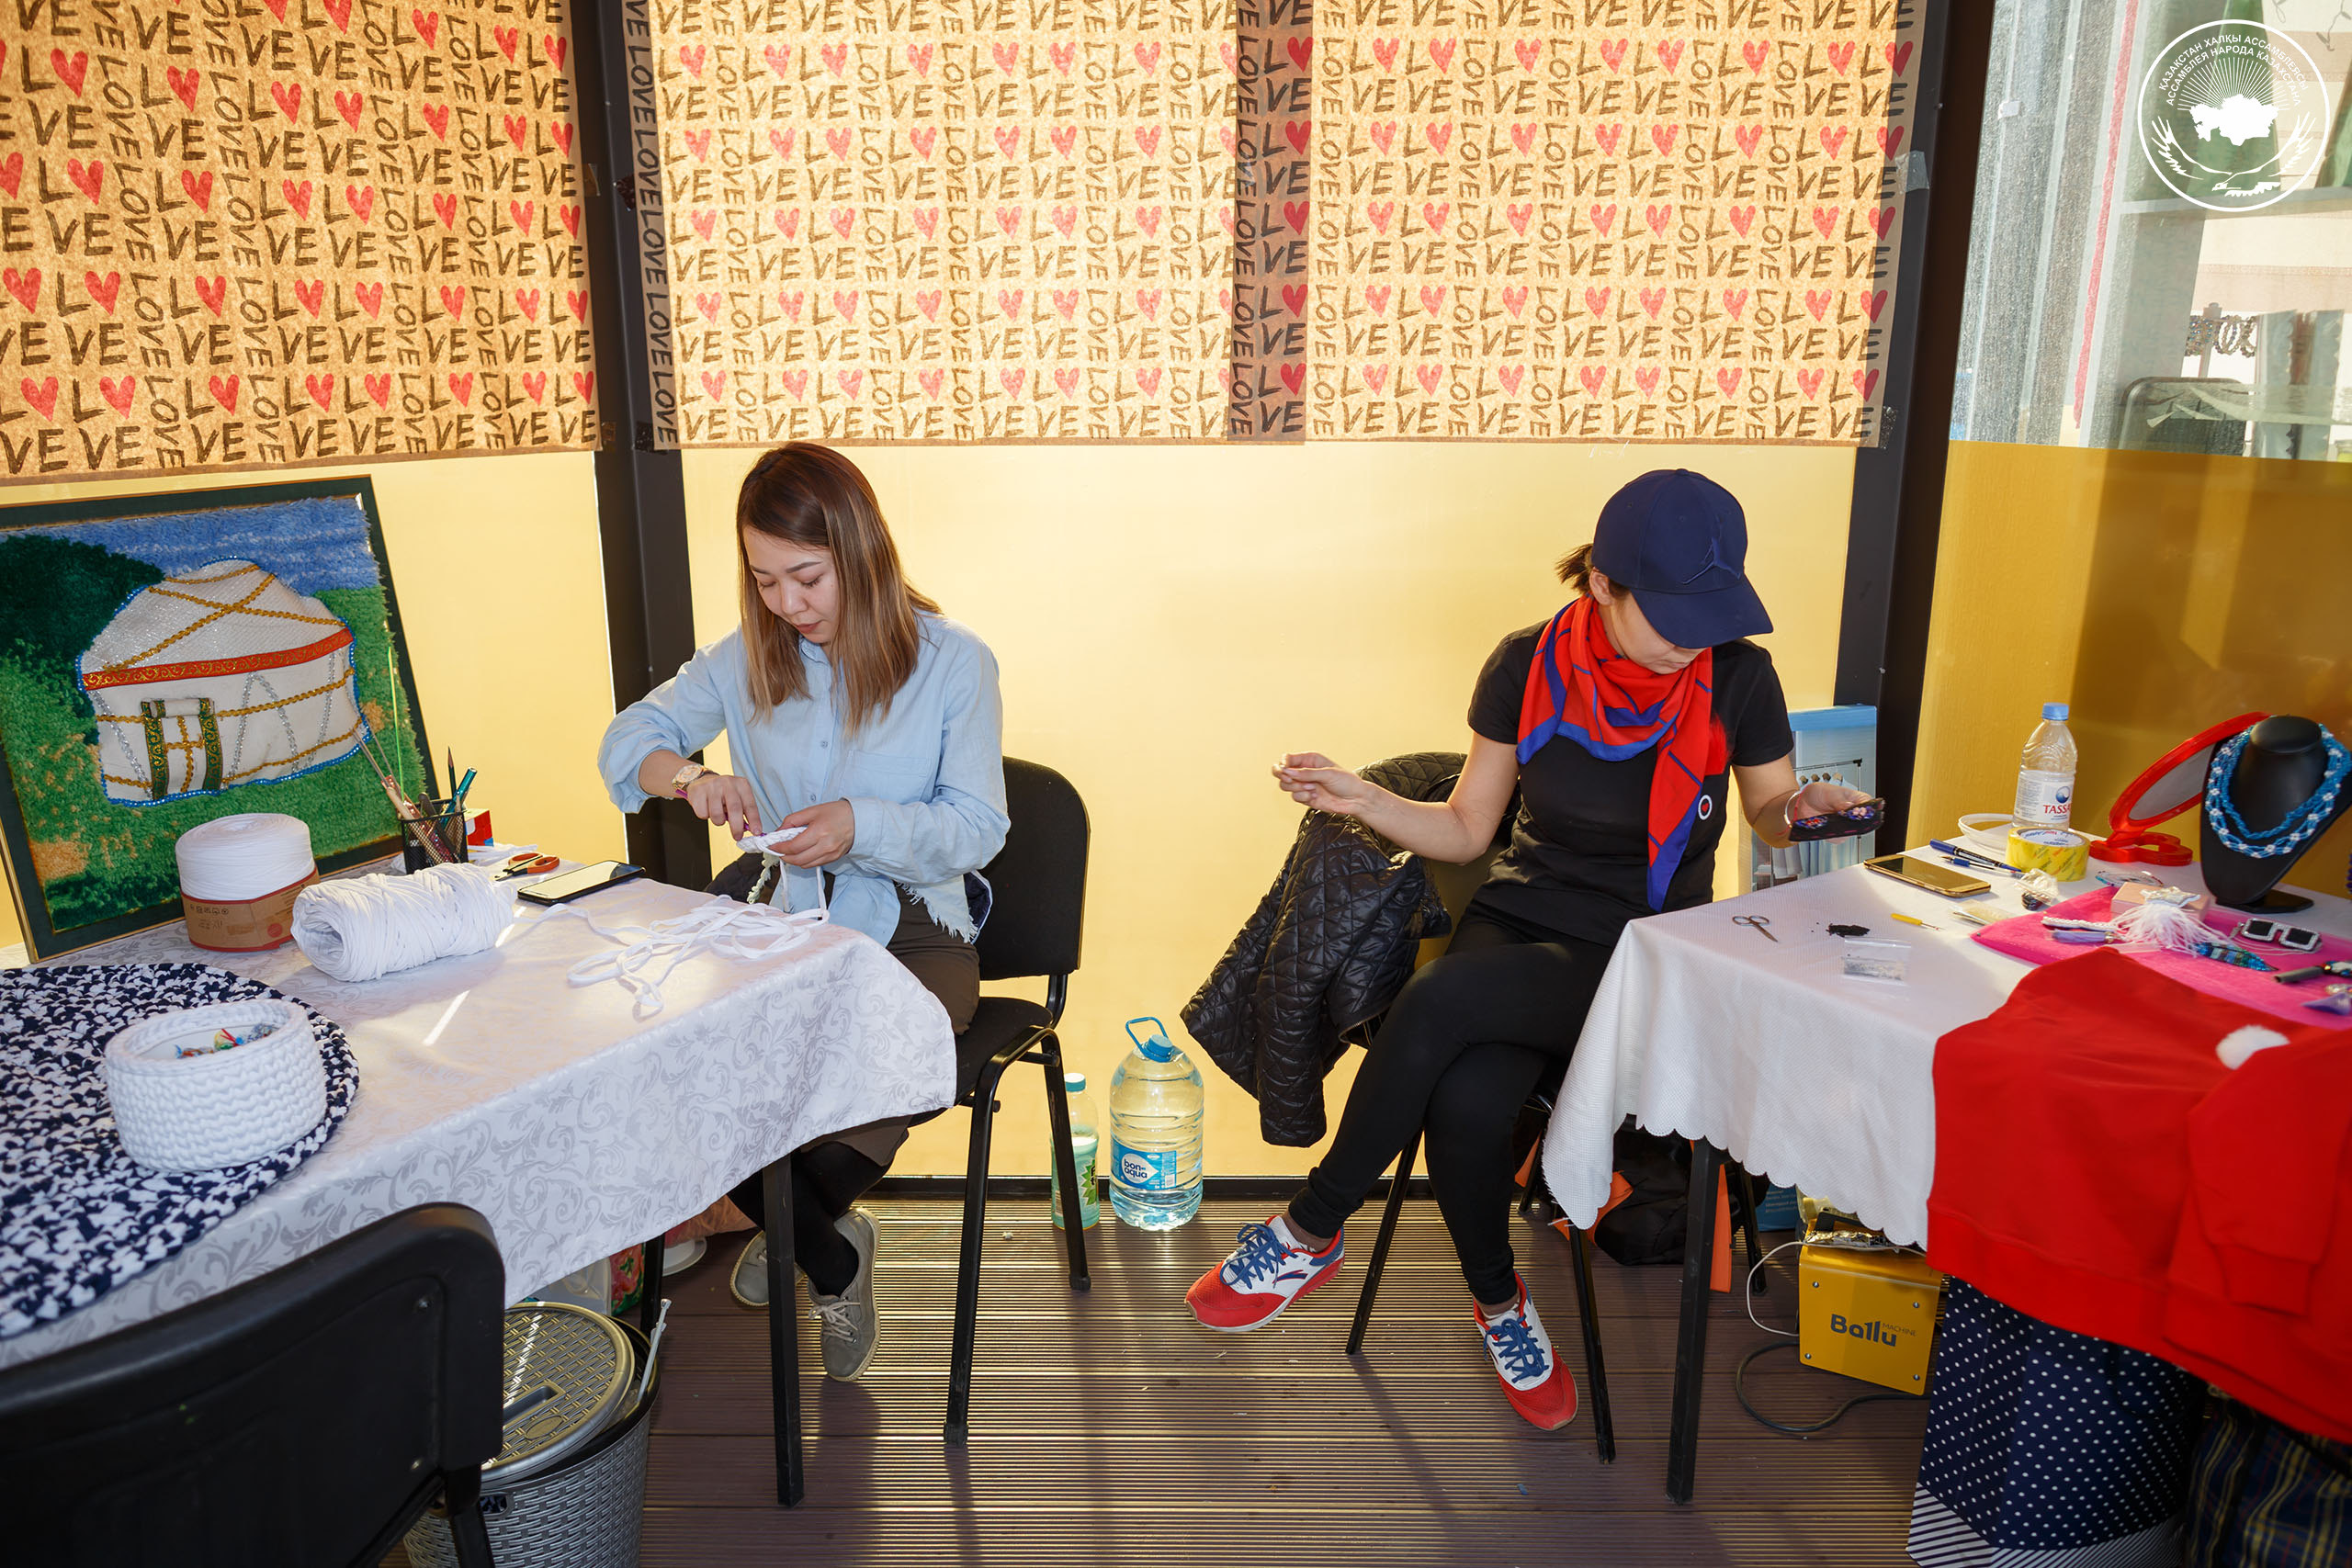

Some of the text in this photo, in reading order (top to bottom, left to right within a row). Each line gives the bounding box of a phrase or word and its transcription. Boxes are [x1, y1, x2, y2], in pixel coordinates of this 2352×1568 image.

[98, 56, 185, 467] LOVE LOVE LOVE LOVE
[210, 73, 286, 462] LOVE LOVE LOVE LOVE
[360, 0, 427, 454] LOVE LOVE LOVE LOVE LOVE
[447, 16, 504, 447] LOVE LOVE LOVE LOVE LOVE
[630, 46, 679, 444] LOVE LOVE LOVE LOVE LOVE
[716, 47, 759, 442] LOVE LOVE LOVE LOVE LOVE
[856, 45, 895, 440] LOVE LOVE LOVE LOVE LOVE
[943, 43, 974, 438] LOVE LOVE LOVE LOVE LOVE
[1085, 42, 1110, 438] LOVE LOVE LOVE LOVE LOVE
[1170, 43, 1193, 438] LOVE LOVE LOVE LOVE LOVE
[1231, 34, 1259, 435] LOVE LOVE LOVE LOVE LOVE
[1316, 39, 1345, 434] LOVE LOVE LOVE LOVE LOVE
[1450, 40, 1487, 436] LOVE LOVE LOVE LOVE LOVE
[1532, 39, 1573, 437] LOVE LOVE LOVE LOVE LOVE
[1666, 41, 1715, 436] LOVE LOVE LOVE LOVE LOVE
[1748, 41, 1800, 438] LOVE LOVE LOVE LOVE LOVE
[1124, 1167, 1148, 1179] aqua
[1830, 1314, 1897, 1347] Ballu
